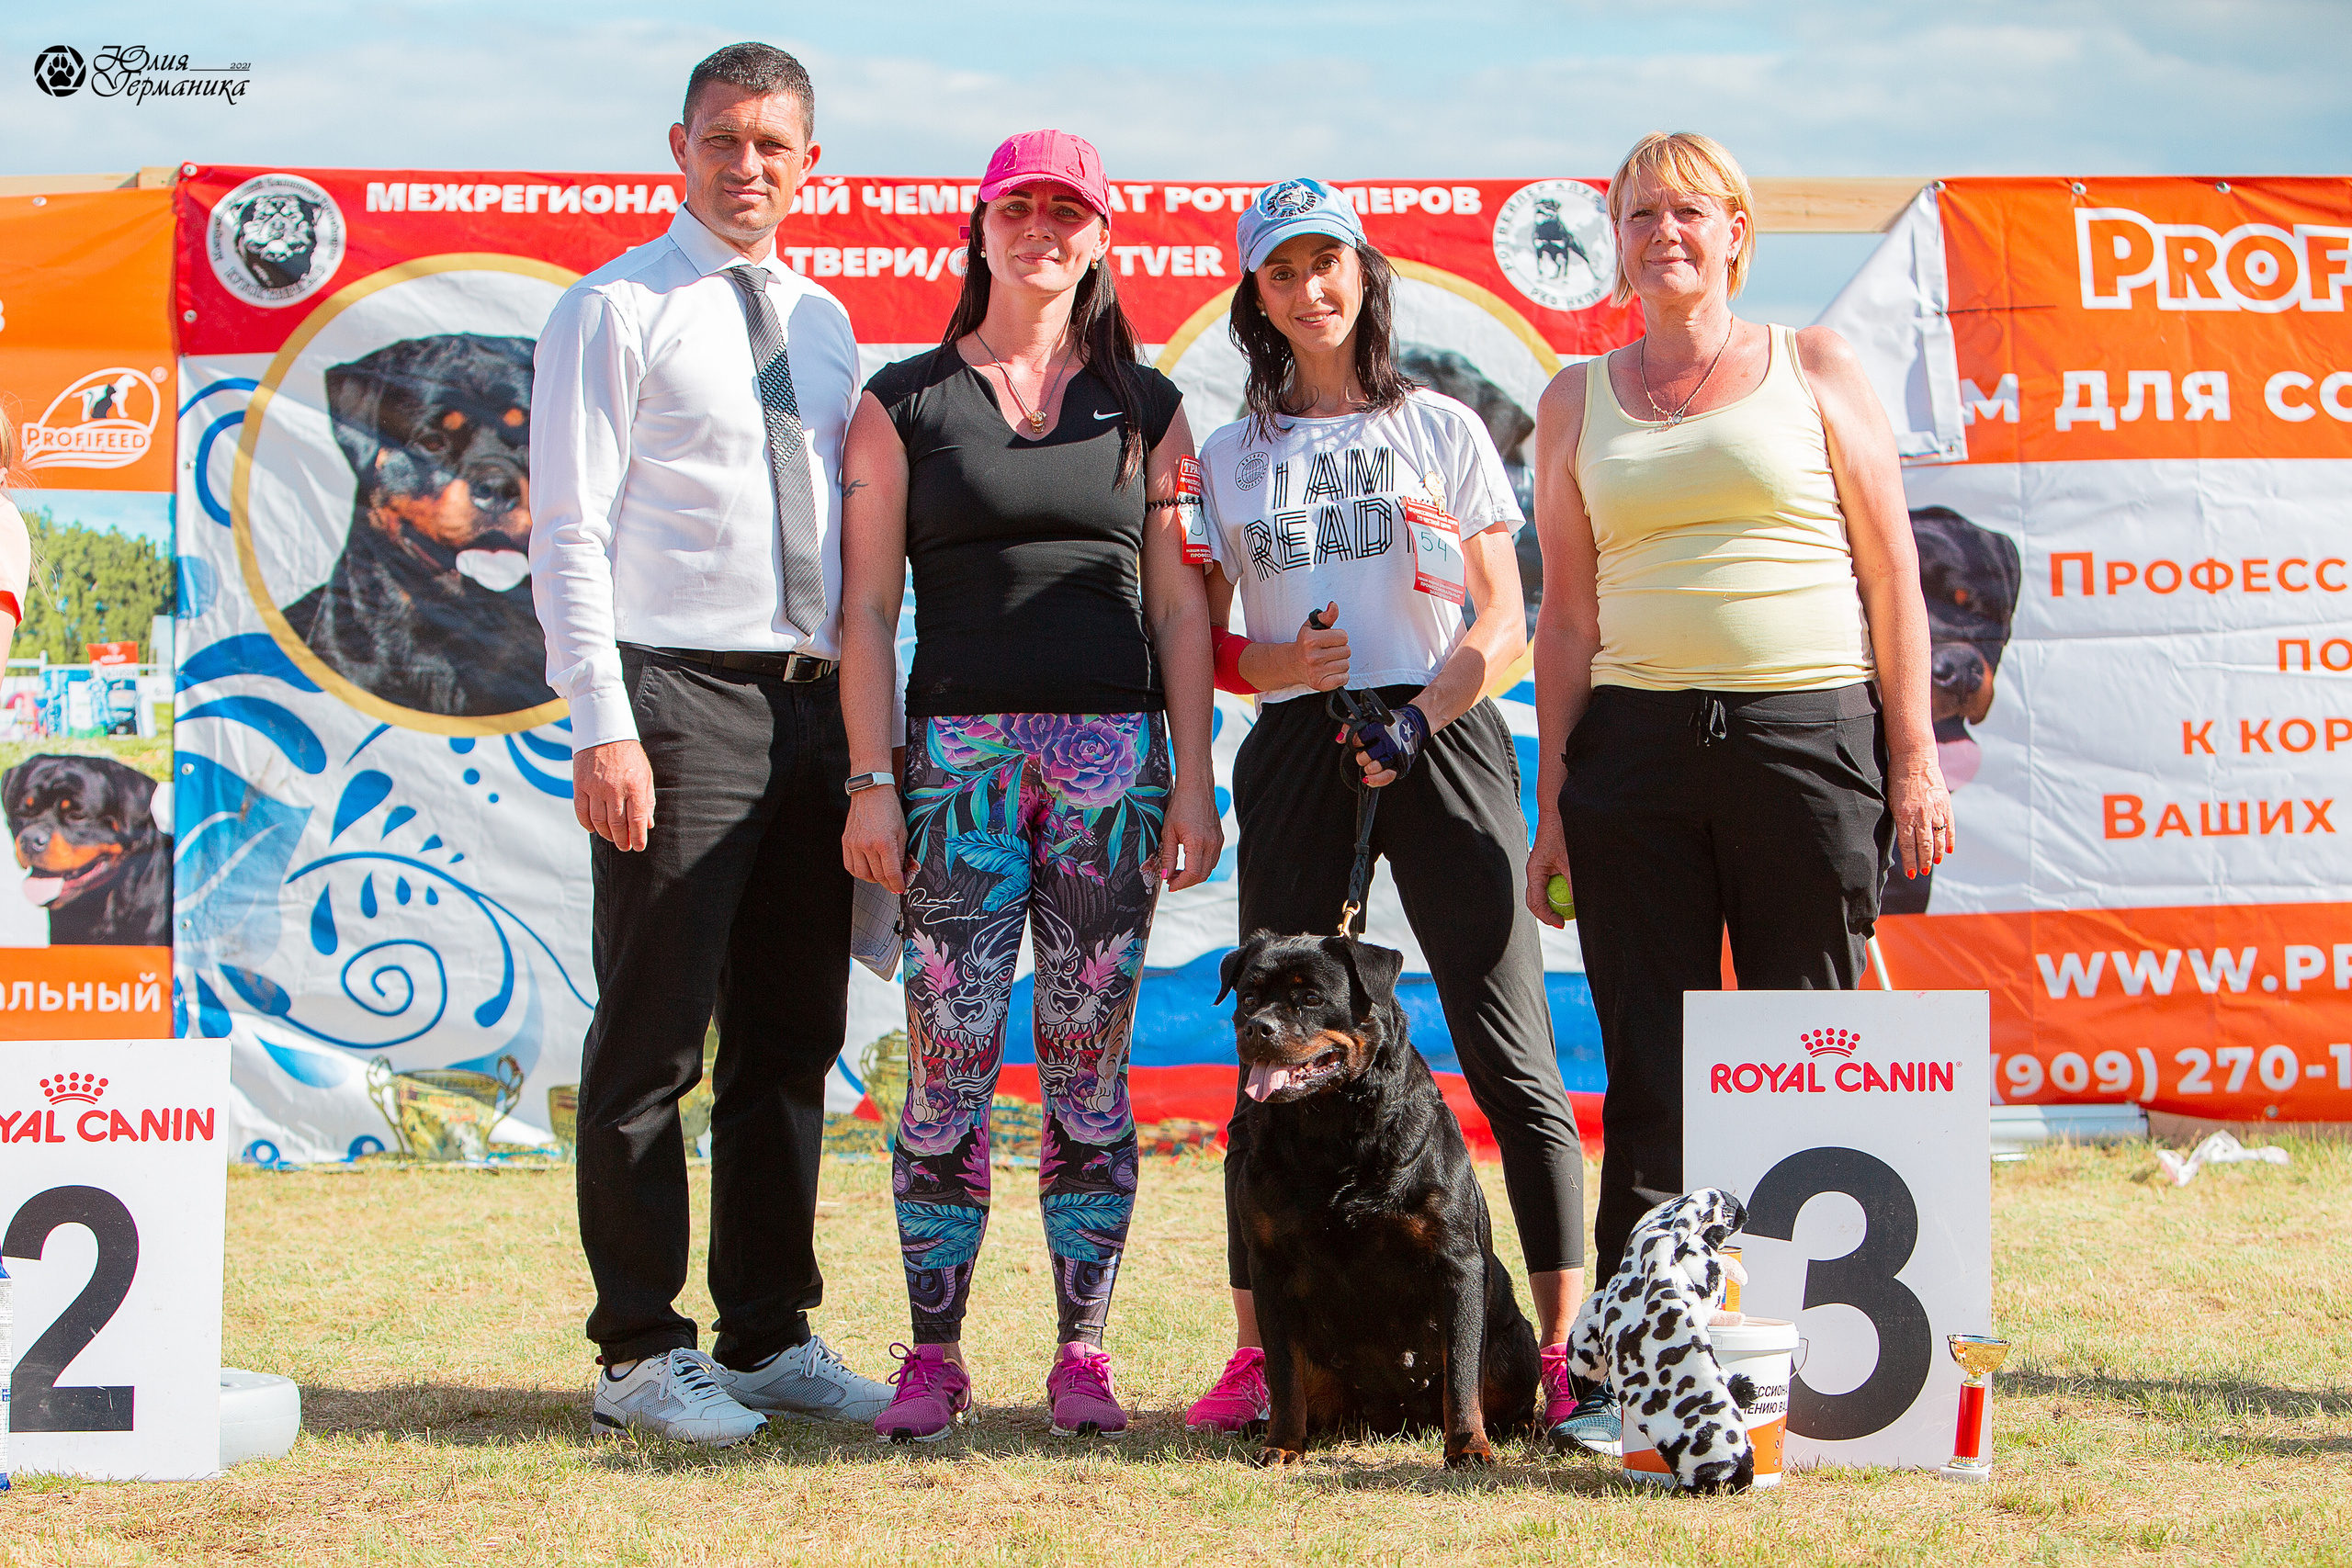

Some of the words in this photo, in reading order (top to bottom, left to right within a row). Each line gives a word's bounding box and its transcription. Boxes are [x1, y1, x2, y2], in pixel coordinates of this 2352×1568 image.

[862, 184, 1154, 214] ЧЕМПАТ
[1164, 186, 1482, 215] РОТЛЕРОВ
[1112, 245, 1226, 276] TVER
[24, 425, 149, 450] PROFIFEED
[1273, 460, 1288, 509] I
[1304, 446, 1395, 504] AM
[1421, 531, 1447, 561] 54
[0, 972, 161, 1012] льный
[1710, 1062, 1826, 1093] ROYAL
[1835, 1062, 1953, 1093] CANIN
[1989, 1051, 2158, 1104] (909)
[76, 1107, 214, 1142] CANIN
[2, 1185, 140, 1432] 2
[1741, 1146, 1932, 1440] 3
